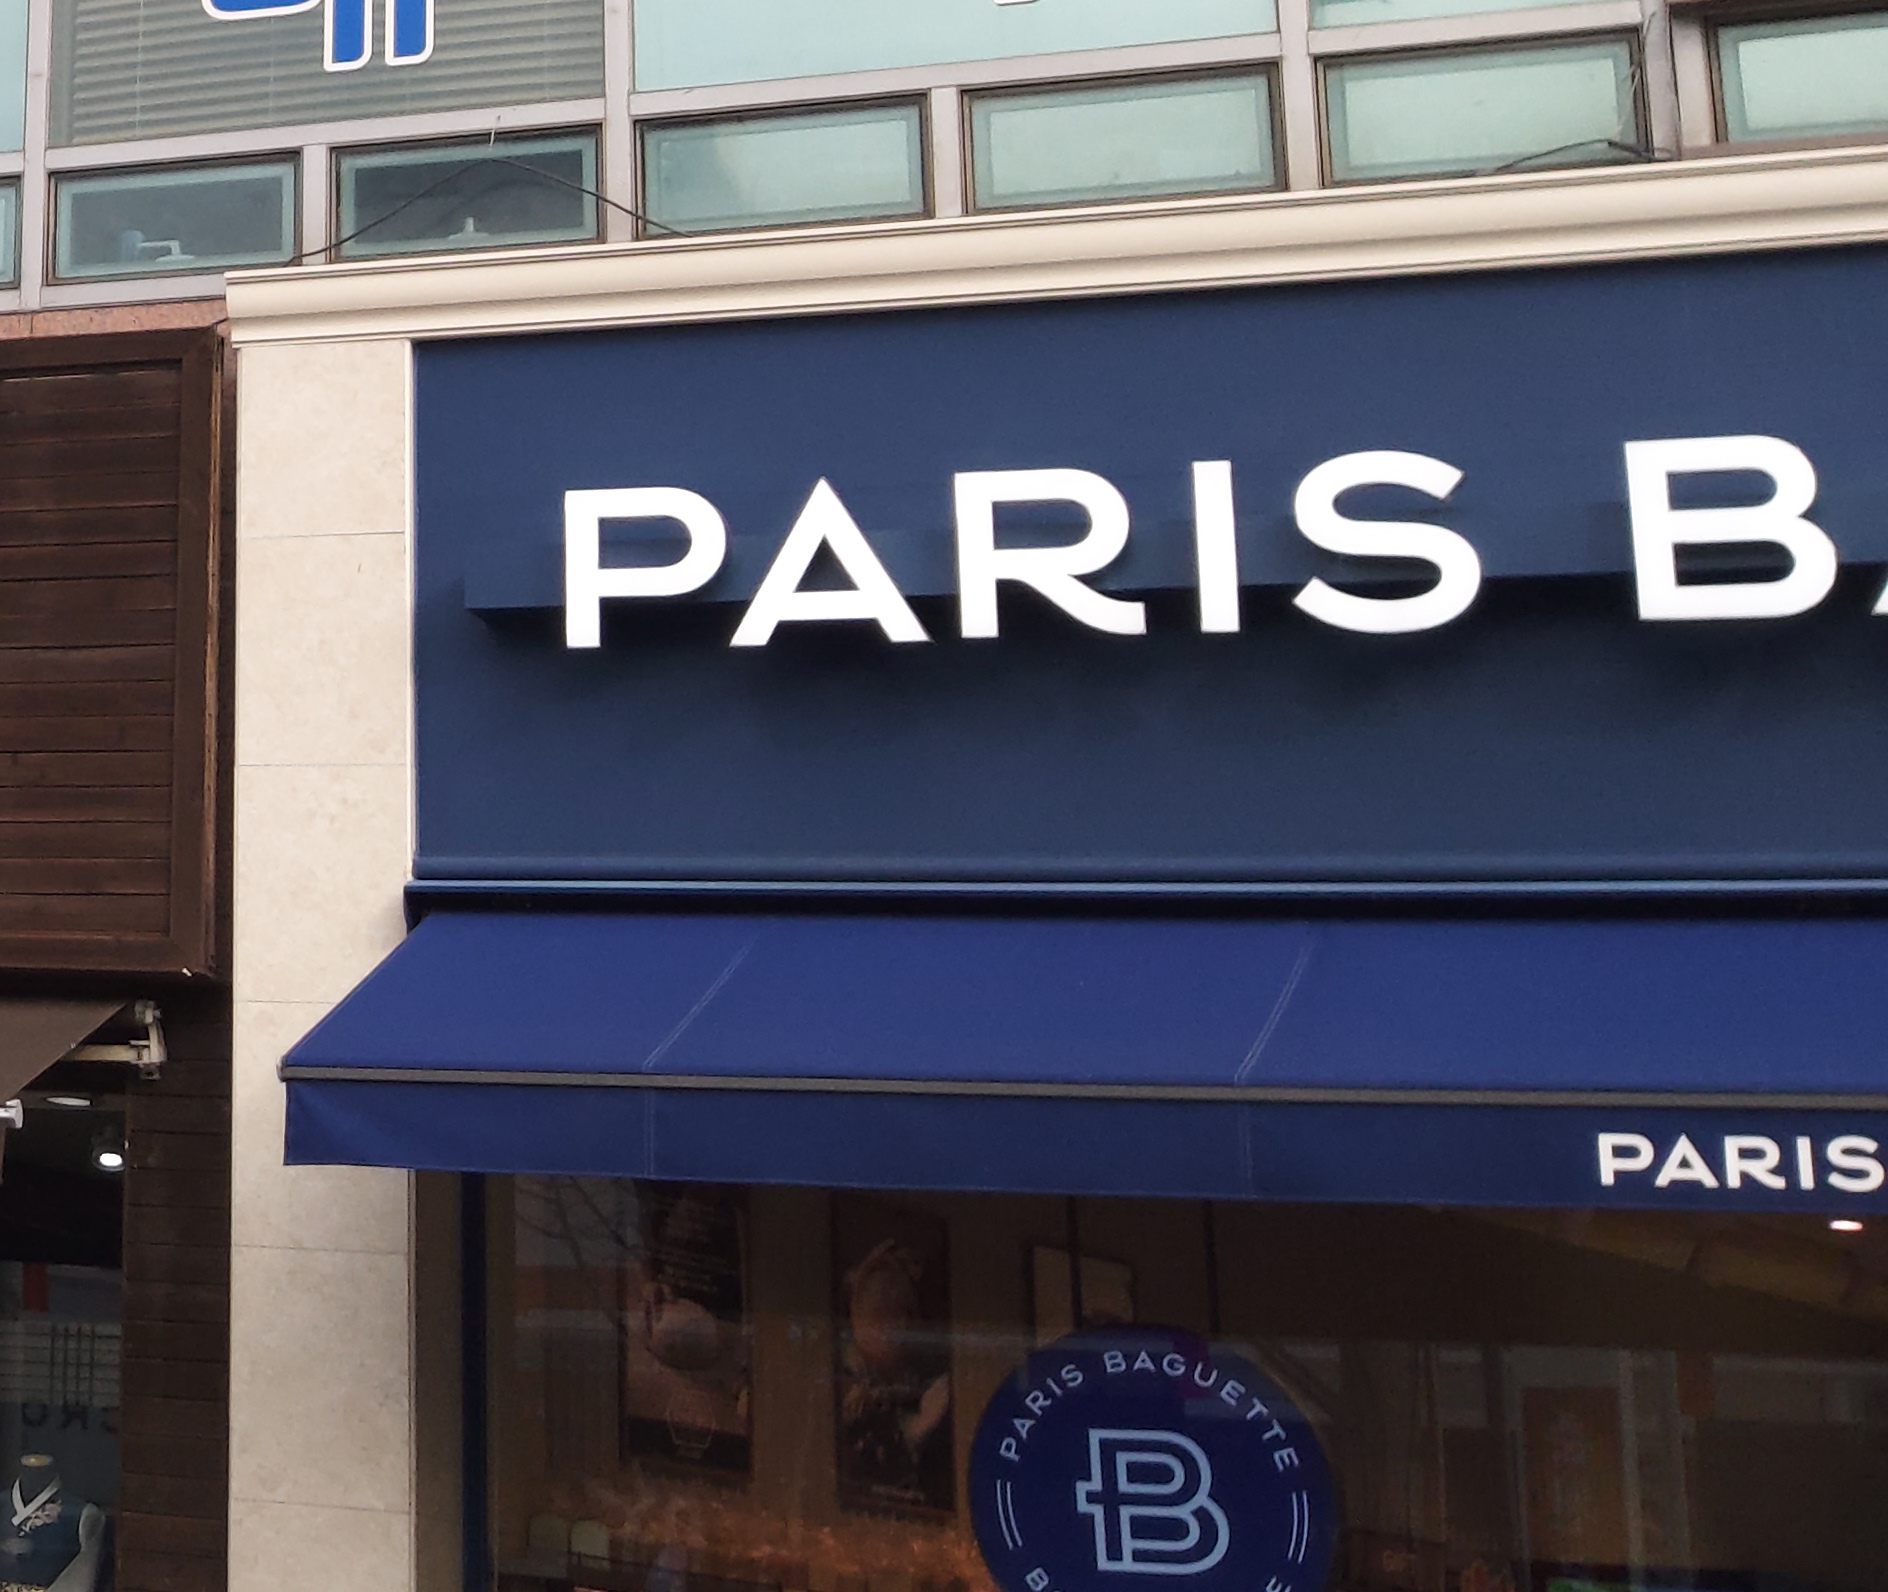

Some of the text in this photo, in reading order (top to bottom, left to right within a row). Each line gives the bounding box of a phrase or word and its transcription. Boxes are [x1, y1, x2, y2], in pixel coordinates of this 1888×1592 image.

[562, 433, 1888, 649] PARIS B
[1597, 1131, 1886, 1194] PARIS
[999, 1350, 1299, 1472] PARIS BAGUETTE
